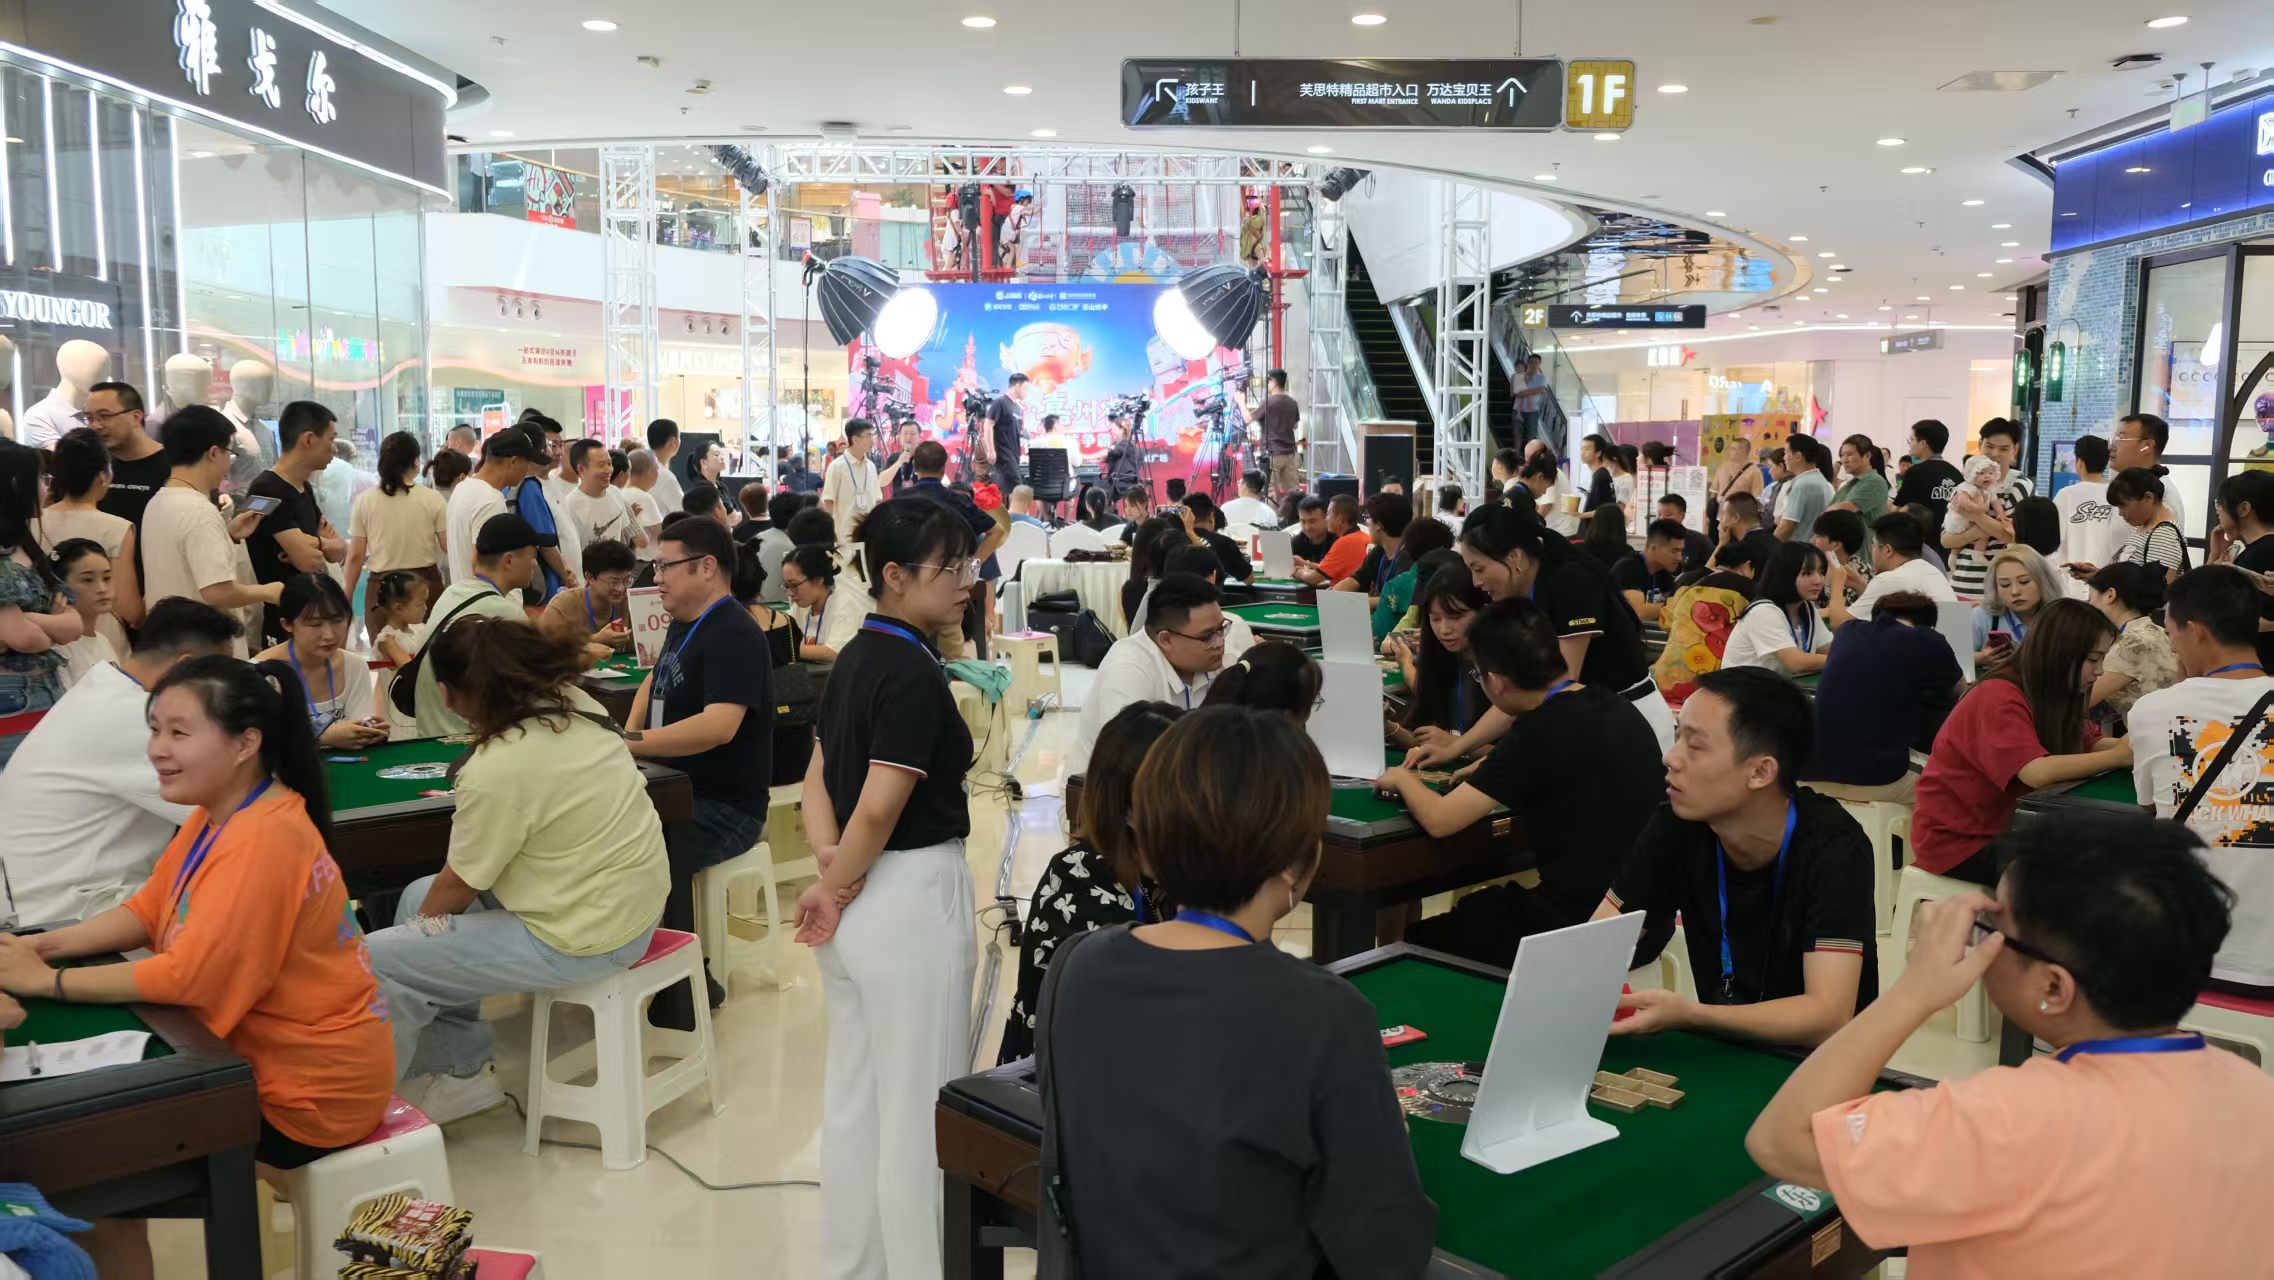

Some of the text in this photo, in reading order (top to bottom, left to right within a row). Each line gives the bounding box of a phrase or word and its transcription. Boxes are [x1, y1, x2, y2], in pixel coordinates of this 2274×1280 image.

[174, 0, 337, 125] 雅戈尔
[1185, 83, 1225, 96] 孩子王
[1300, 83, 1492, 97] 芙思特精品超市入口 万达宝贝王
[1577, 74, 1626, 114] 1F
[0, 289, 113, 330] YOUNGOR
[1524, 308, 1546, 325] 2F
